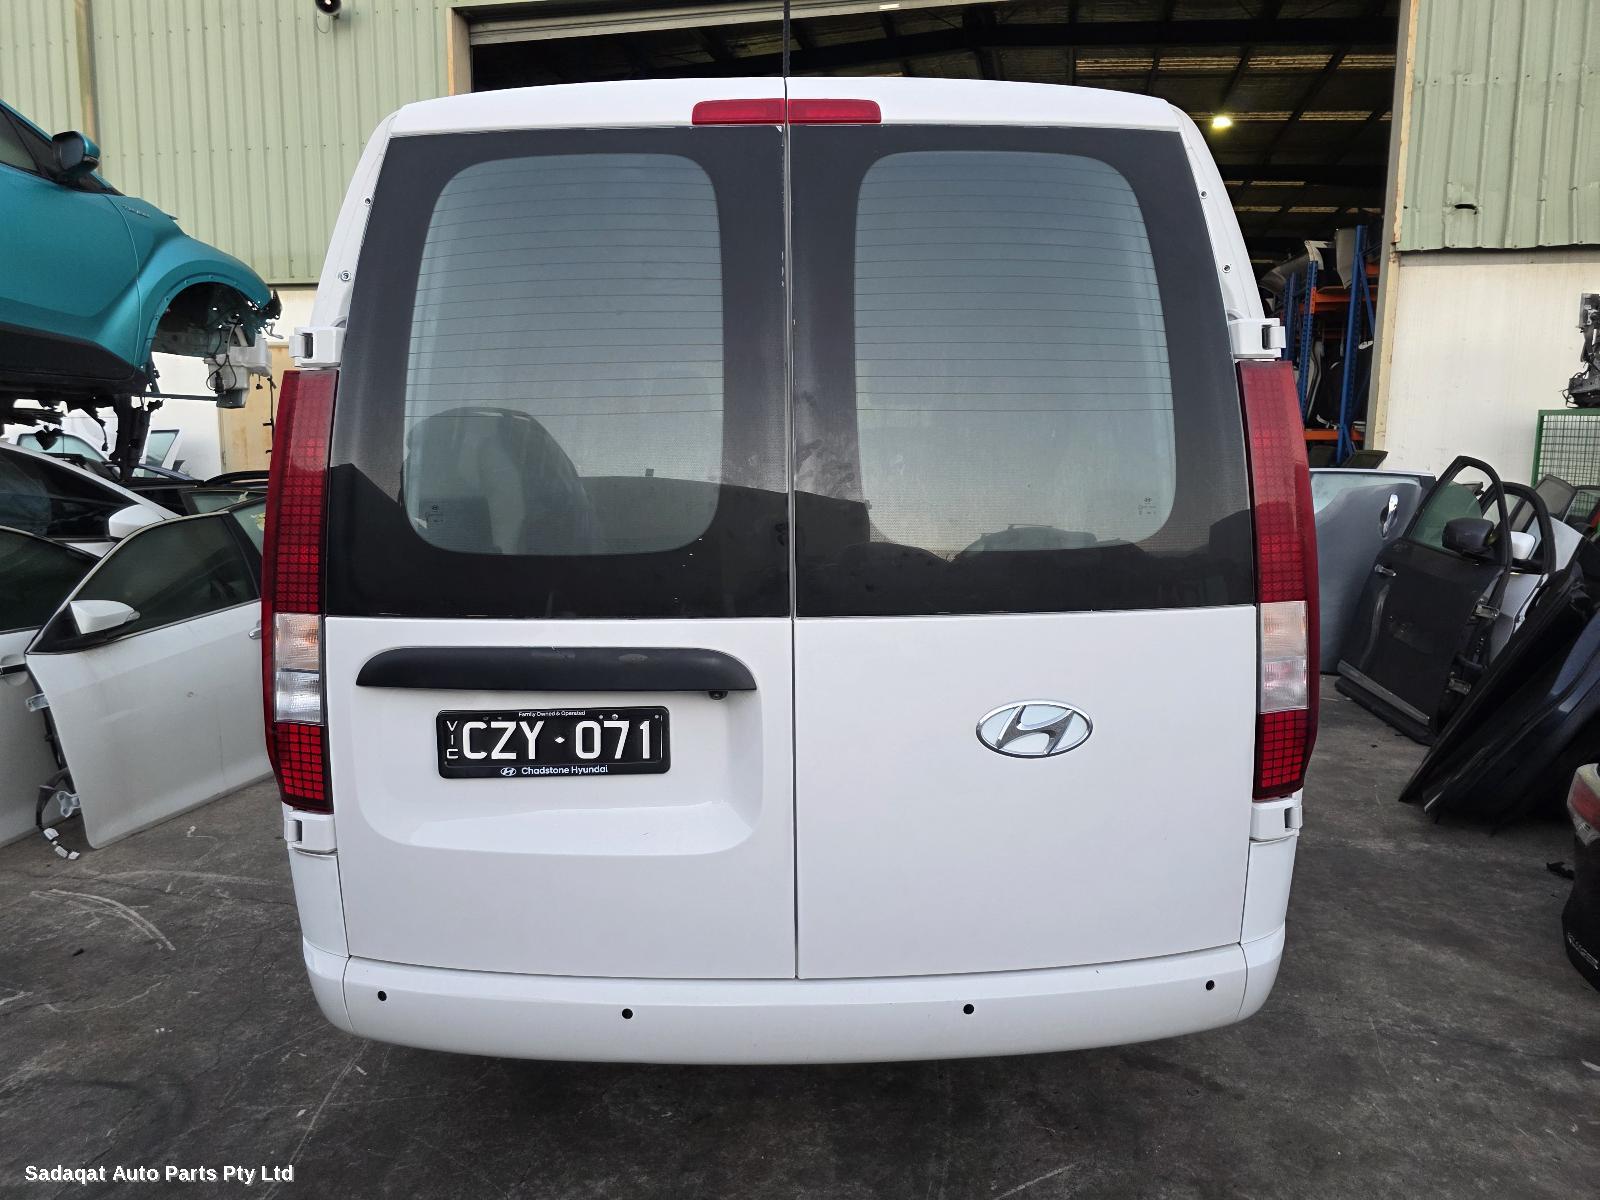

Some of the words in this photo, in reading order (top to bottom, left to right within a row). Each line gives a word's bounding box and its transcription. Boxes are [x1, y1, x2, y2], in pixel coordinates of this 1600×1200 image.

[446, 720, 459, 759] VIC
[462, 720, 545, 760] CZY
[575, 720, 651, 760] 071
[521, 766, 570, 775] Chadstone
[571, 764, 609, 776] Hyundai
